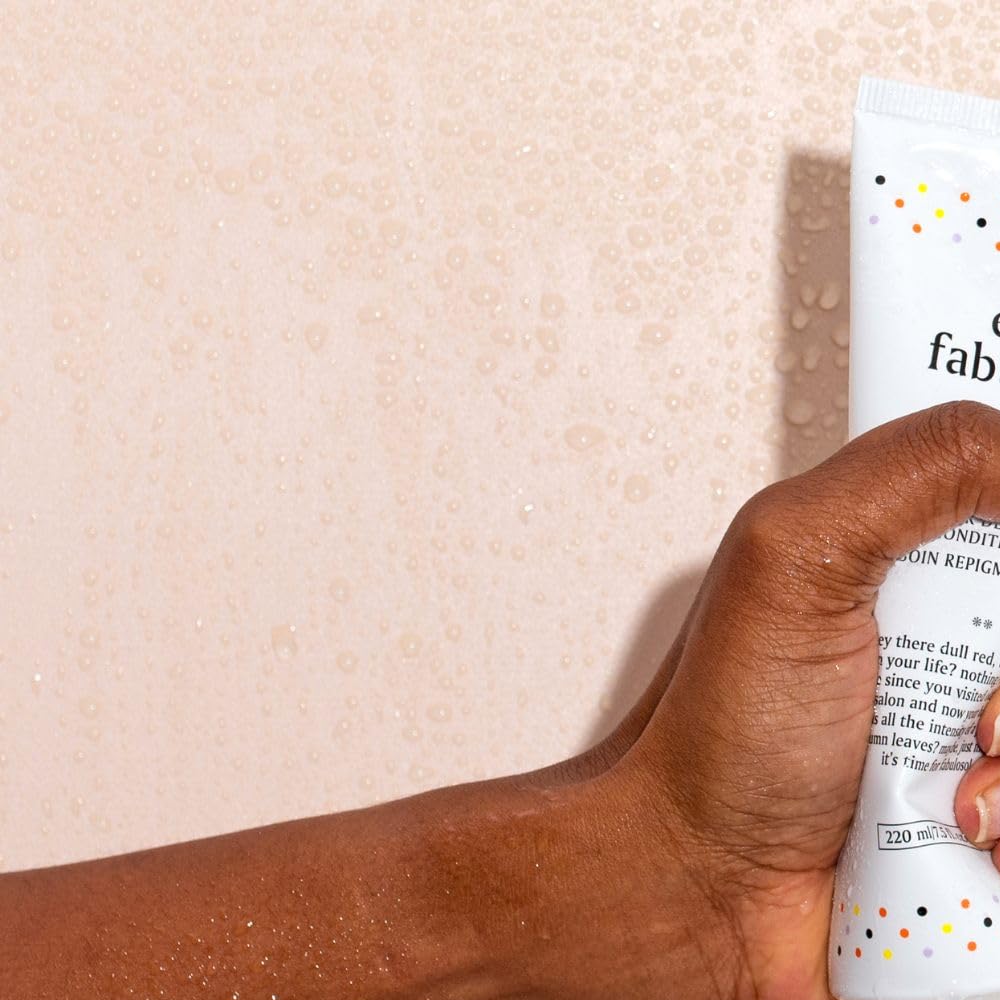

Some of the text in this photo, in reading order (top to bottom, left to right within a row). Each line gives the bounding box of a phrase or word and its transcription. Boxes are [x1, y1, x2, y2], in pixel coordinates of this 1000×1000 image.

[878, 635, 893, 650] ey
[896, 634, 935, 653] there
[940, 641, 969, 660] dull
[973, 651, 995, 668] red,
[886, 655, 921, 670] your
[924, 657, 957, 677] life?
[885, 672, 921, 690] since
[923, 681, 952, 696] you
[909, 698, 938, 713] and
[941, 704, 965, 718] now
[881, 712, 896, 726] all
[900, 714, 925, 731] the
[891, 732, 940, 754] leaves?
[881, 751, 898, 766] it's
[904, 755, 930, 772] time
[885, 829, 912, 844] 220
